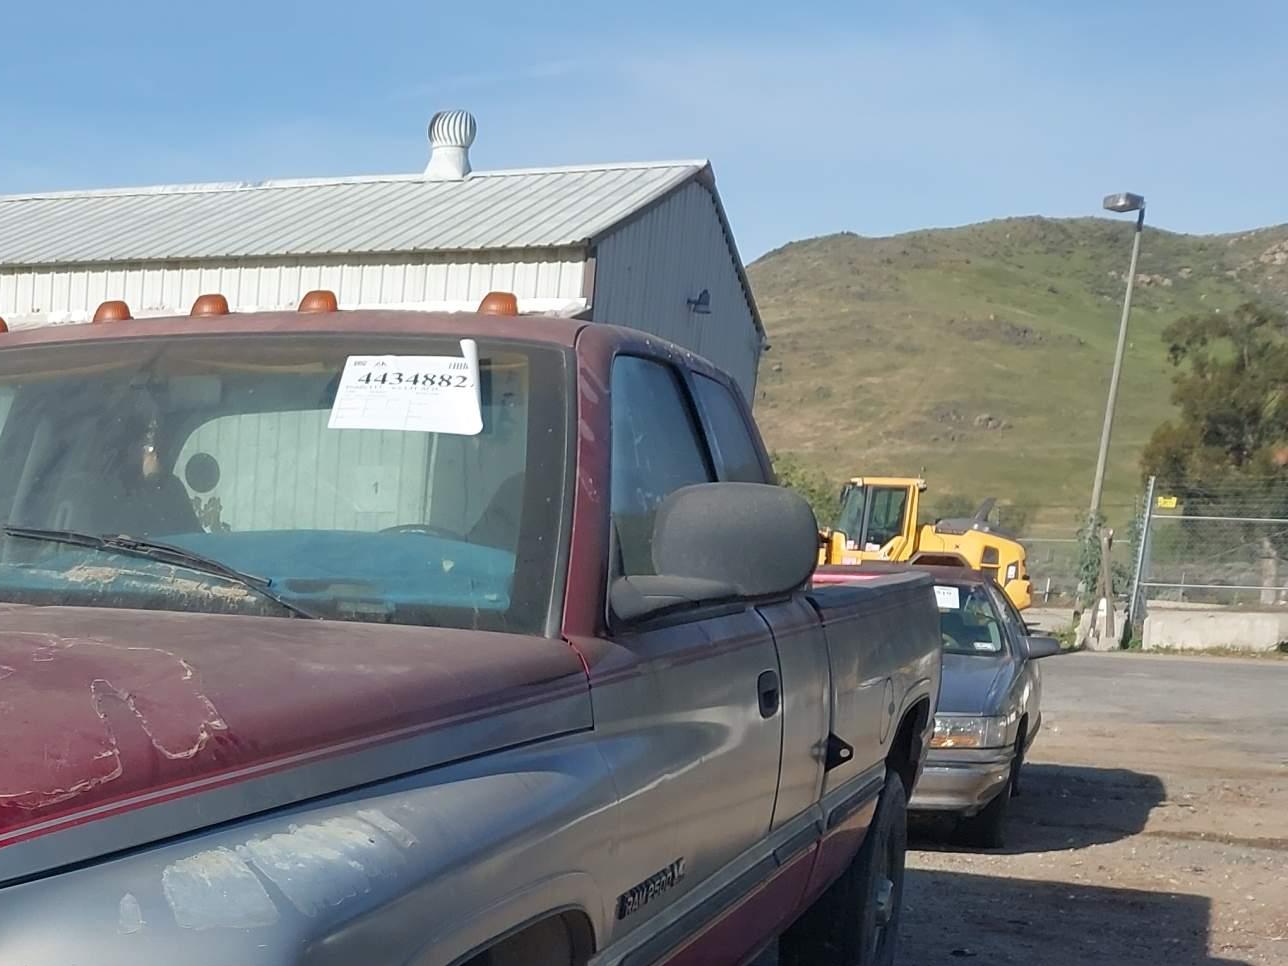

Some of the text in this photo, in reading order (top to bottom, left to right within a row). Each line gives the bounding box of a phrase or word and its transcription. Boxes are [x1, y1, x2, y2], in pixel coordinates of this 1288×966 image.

[358, 371, 475, 390] 4434882
[372, 481, 379, 495] 1
[626, 886, 649, 915] RAM
